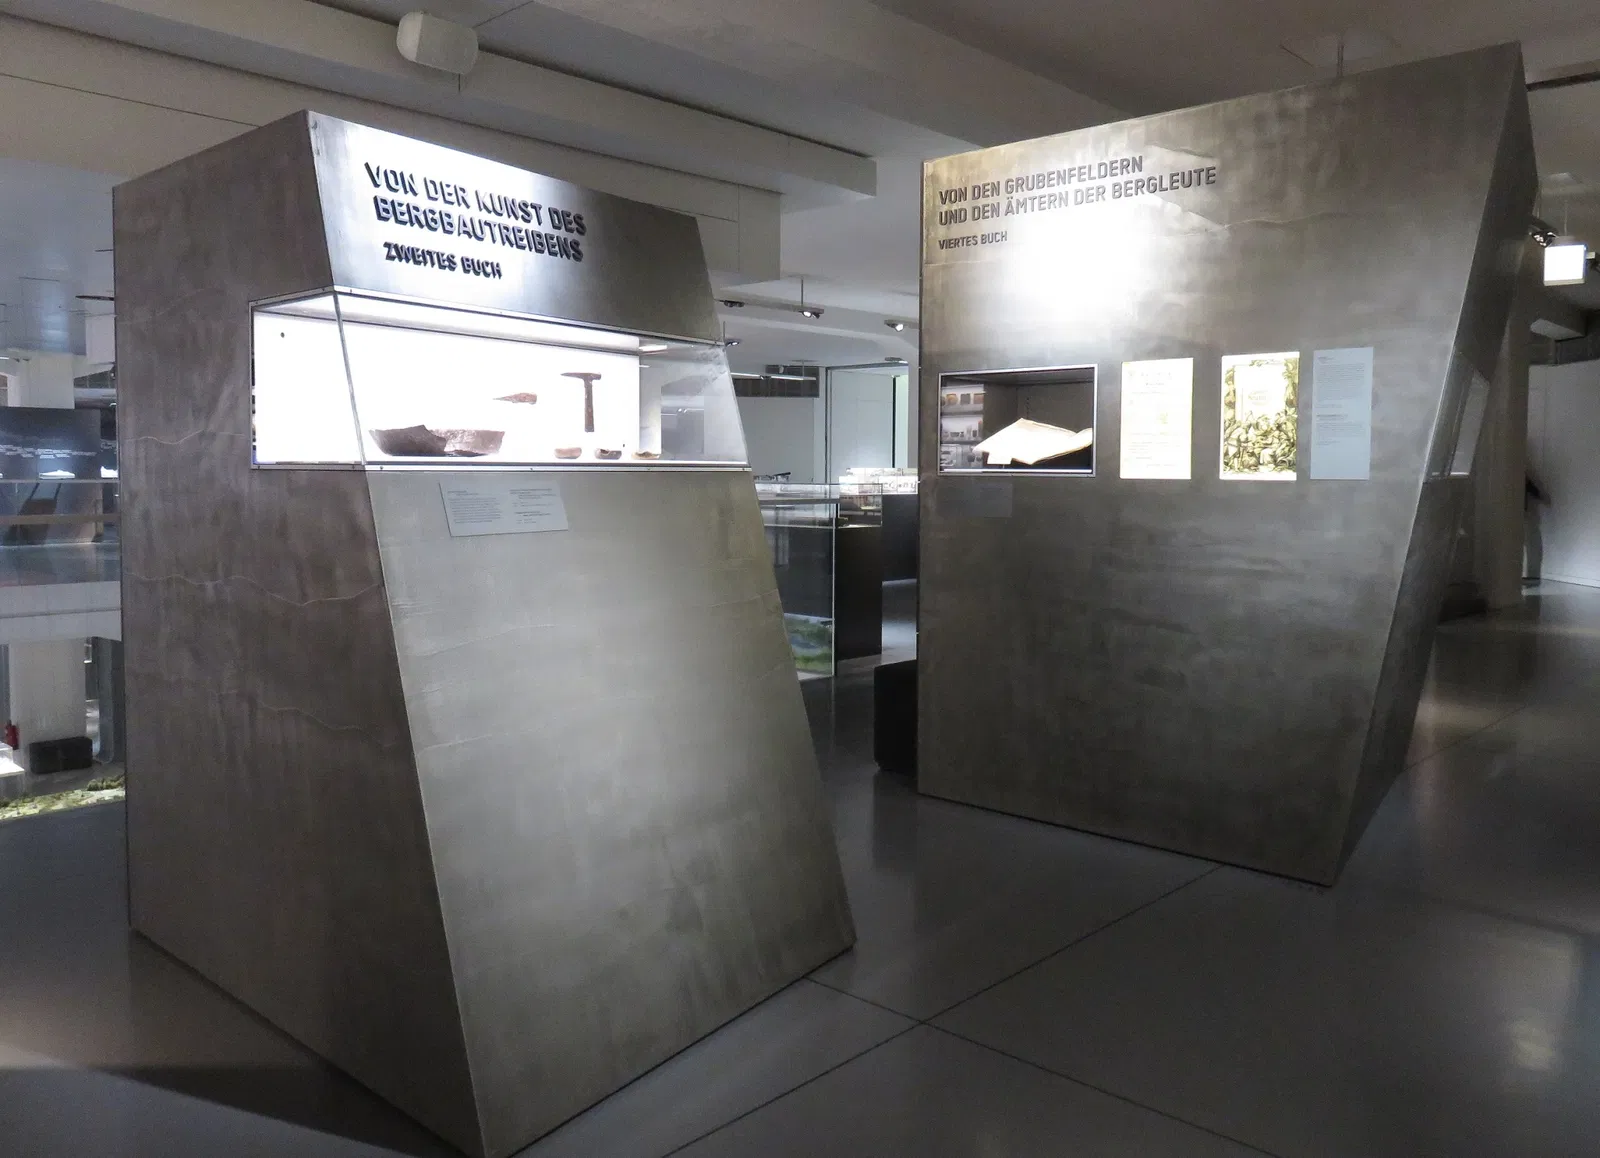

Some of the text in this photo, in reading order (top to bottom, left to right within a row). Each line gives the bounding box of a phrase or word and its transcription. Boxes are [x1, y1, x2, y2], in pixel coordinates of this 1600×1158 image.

[364, 162, 587, 236] VON DER KUNST DES
[939, 156, 1143, 205] VON DEN GRUBENFELDERN
[939, 166, 1217, 226] UND DEN ÄMTERN DER BERGLEUTE
[373, 195, 584, 262] BERGBAUTREIBENS
[938, 231, 1008, 250] VIERTES BUCH
[383, 241, 502, 279] ZWEITES BUCH
